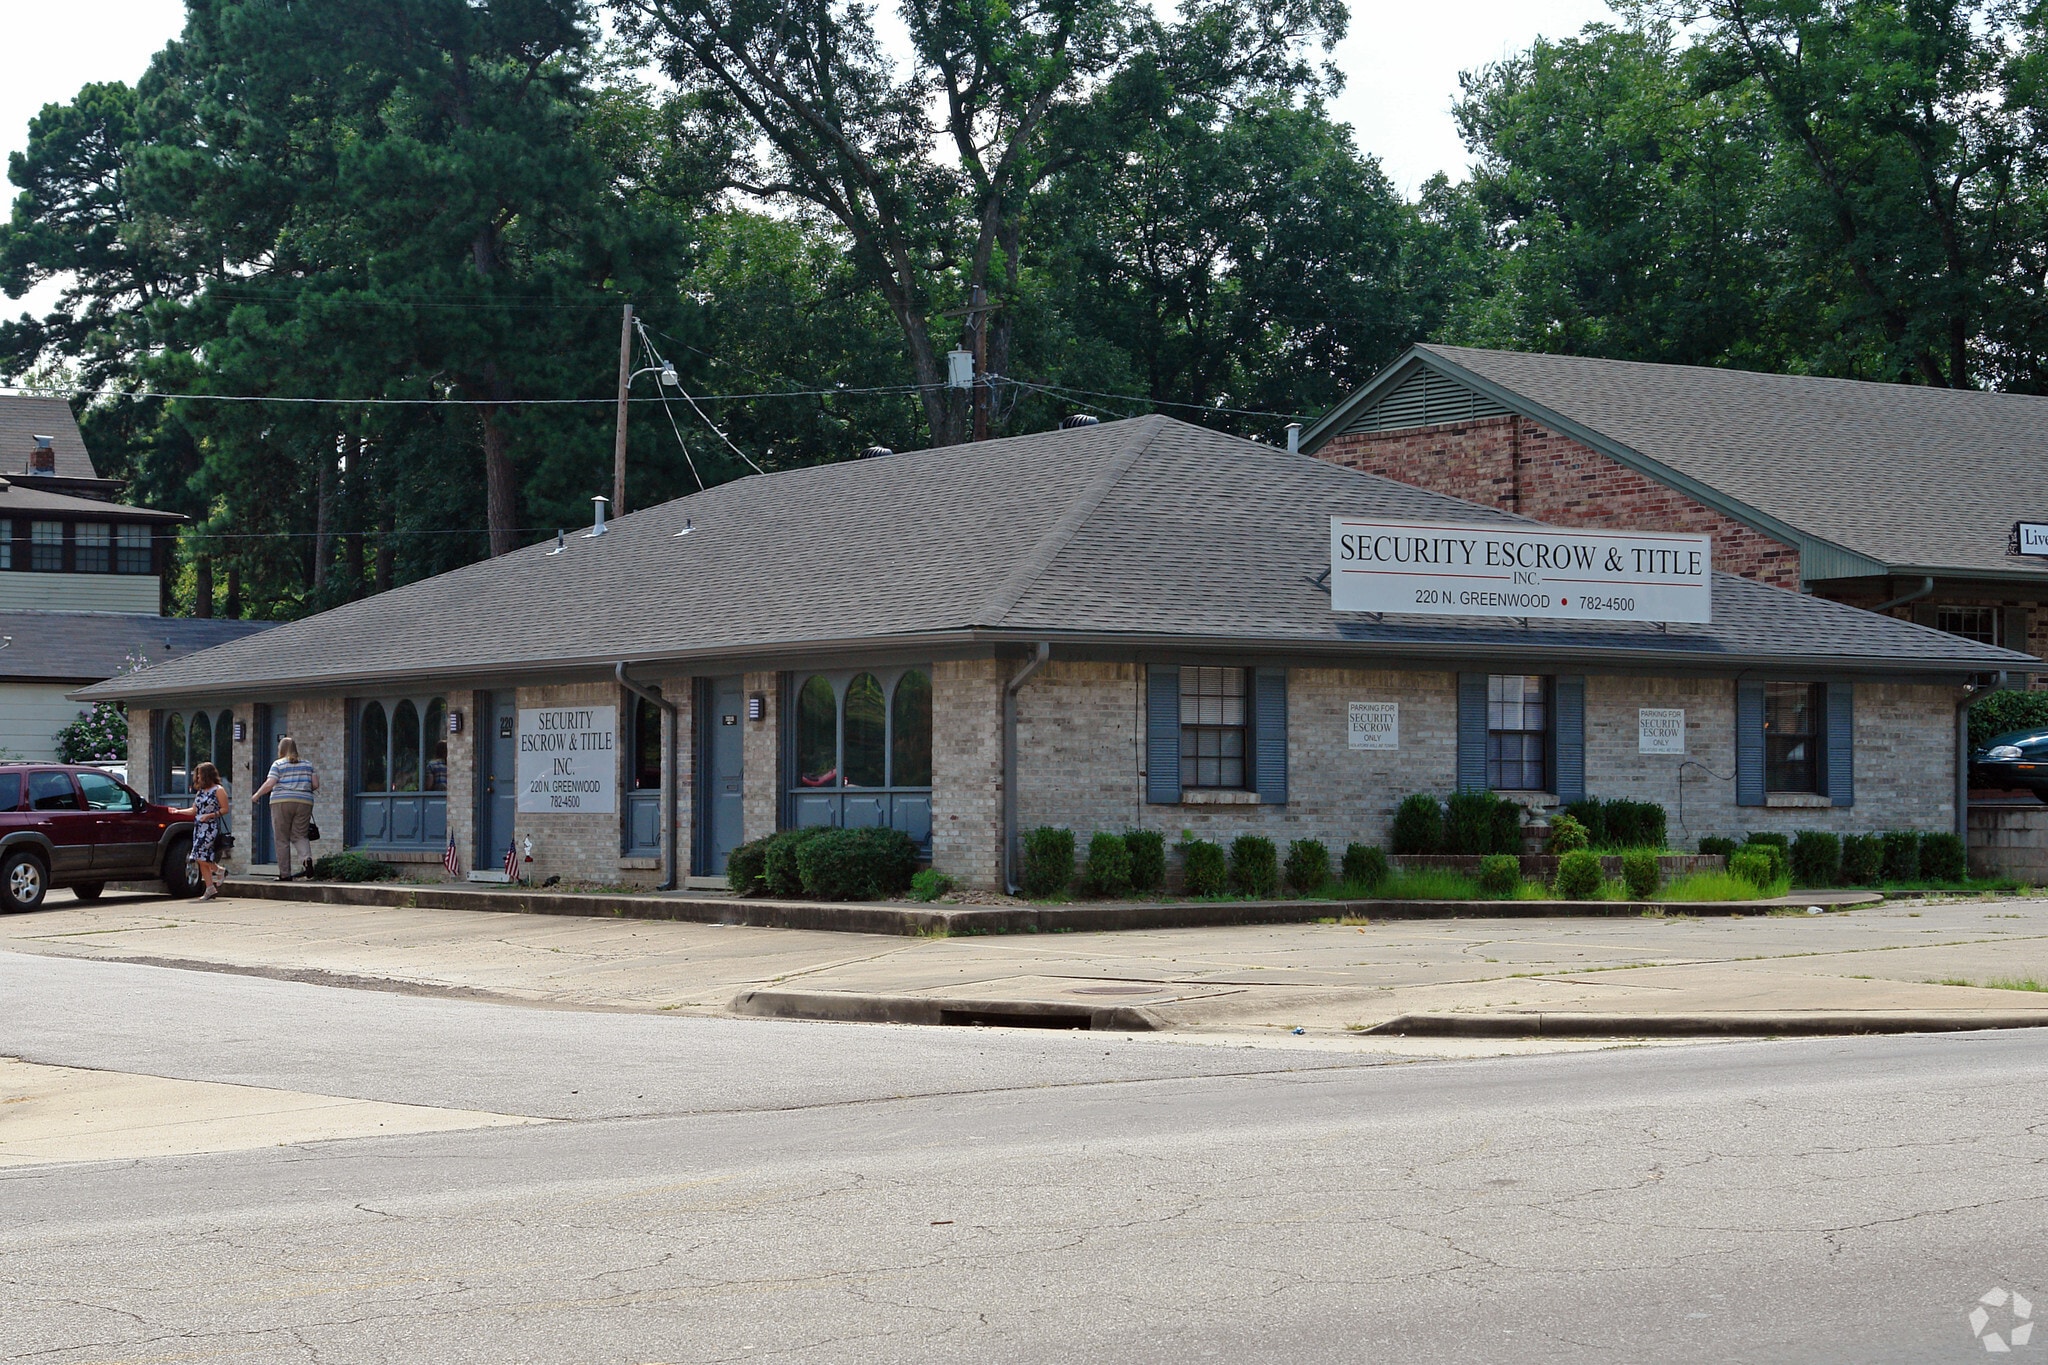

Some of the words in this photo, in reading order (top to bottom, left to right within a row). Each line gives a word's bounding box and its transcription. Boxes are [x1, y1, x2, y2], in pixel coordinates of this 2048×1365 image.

[1340, 534, 1477, 565] SECURITY
[1485, 540, 1597, 571] ESCROW
[1604, 547, 1624, 572] &
[1631, 548, 1703, 576] TITLE
[1513, 571, 1540, 586] INC.
[1415, 589, 1439, 604] 220
[1442, 591, 1456, 605] N.
[1460, 591, 1550, 609] GREENWOOD
[1580, 596, 1635, 612] 782-4500
[1350, 704, 1379, 712] PARKING
[1640, 710, 1667, 718] PARKING
[500, 717, 513, 729] 220
[538, 712, 593, 730] SECURITY
[1349, 713, 1396, 723] SECURITY
[1640, 719, 1681, 728] SECURITY
[1353, 723, 1392, 732] ESCROW
[1643, 728, 1679, 737] ESCROW
[521, 733, 567, 752] ESCROW
[568, 732, 578, 751] &
[580, 732, 612, 751] TITLE
[1363, 734, 1382, 742] ONLY
[553, 757, 575, 776] INC.
[530, 780, 543, 793] 220
[552, 780, 601, 793] GREENWOOD
[550, 795, 581, 808] 782-4500
